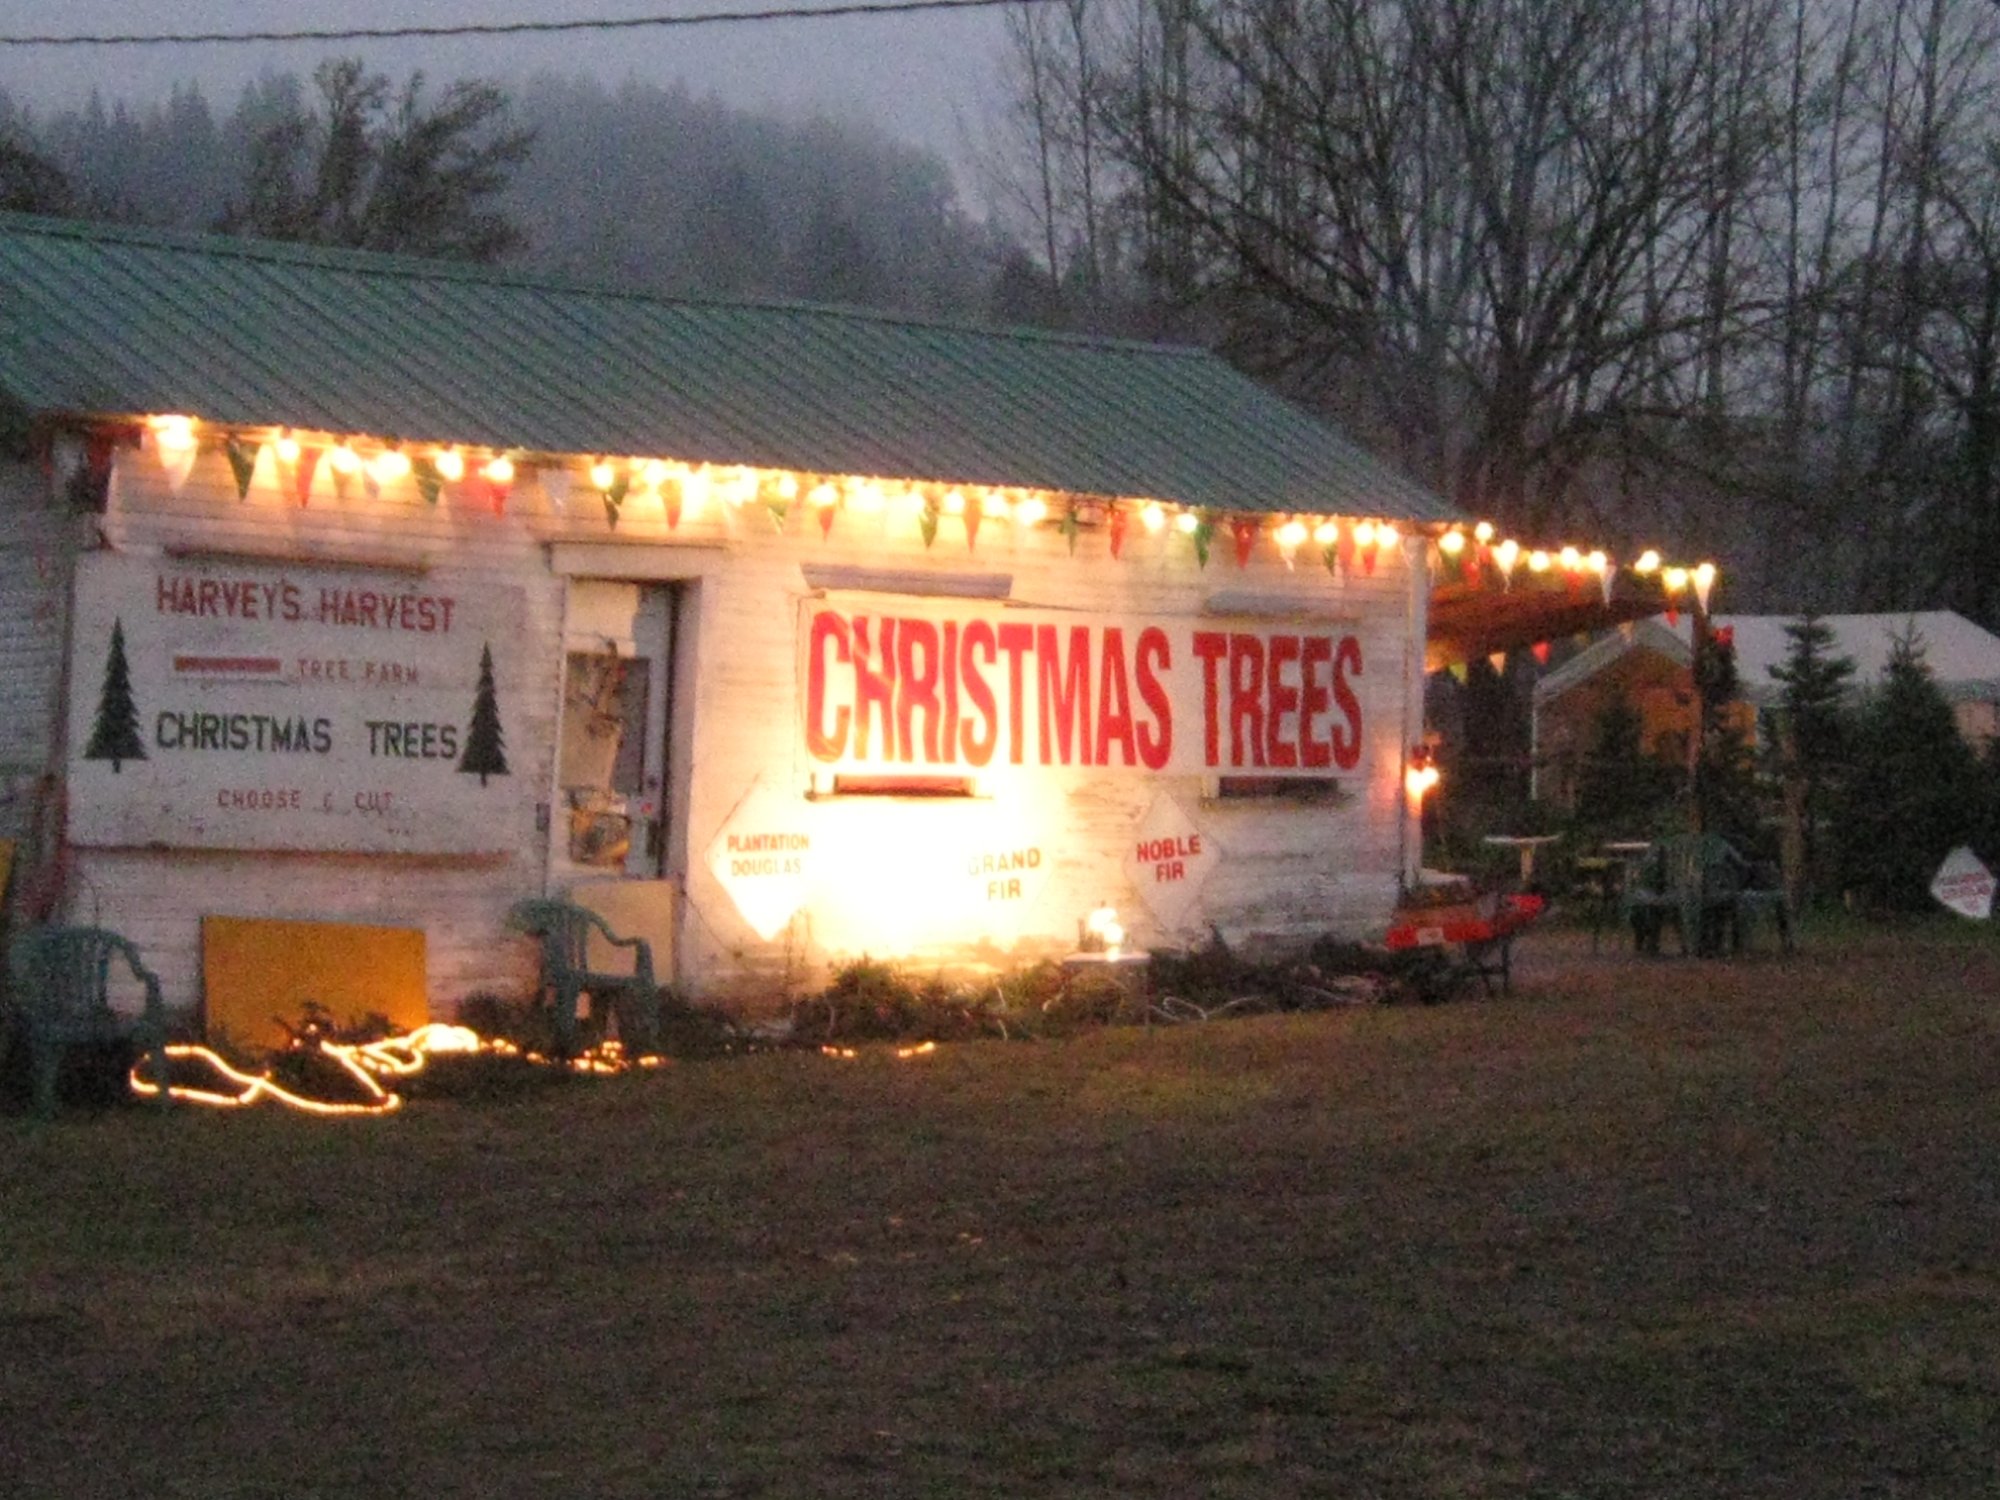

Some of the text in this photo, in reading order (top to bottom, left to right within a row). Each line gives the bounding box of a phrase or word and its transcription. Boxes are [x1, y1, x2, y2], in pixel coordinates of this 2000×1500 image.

[320, 588, 456, 632] HARVEST
[805, 610, 1363, 770] CHRISTMAS TREES
[156, 712, 458, 758] CHRISTMAS TREES
[217, 788, 300, 810] CHOOSE
[727, 834, 809, 852] PLANTATION
[1137, 834, 1201, 862] NOBLE
[731, 857, 801, 877] DOUGLAS
[1156, 861, 1184, 882] FIR
[987, 878, 1021, 901] FIR
